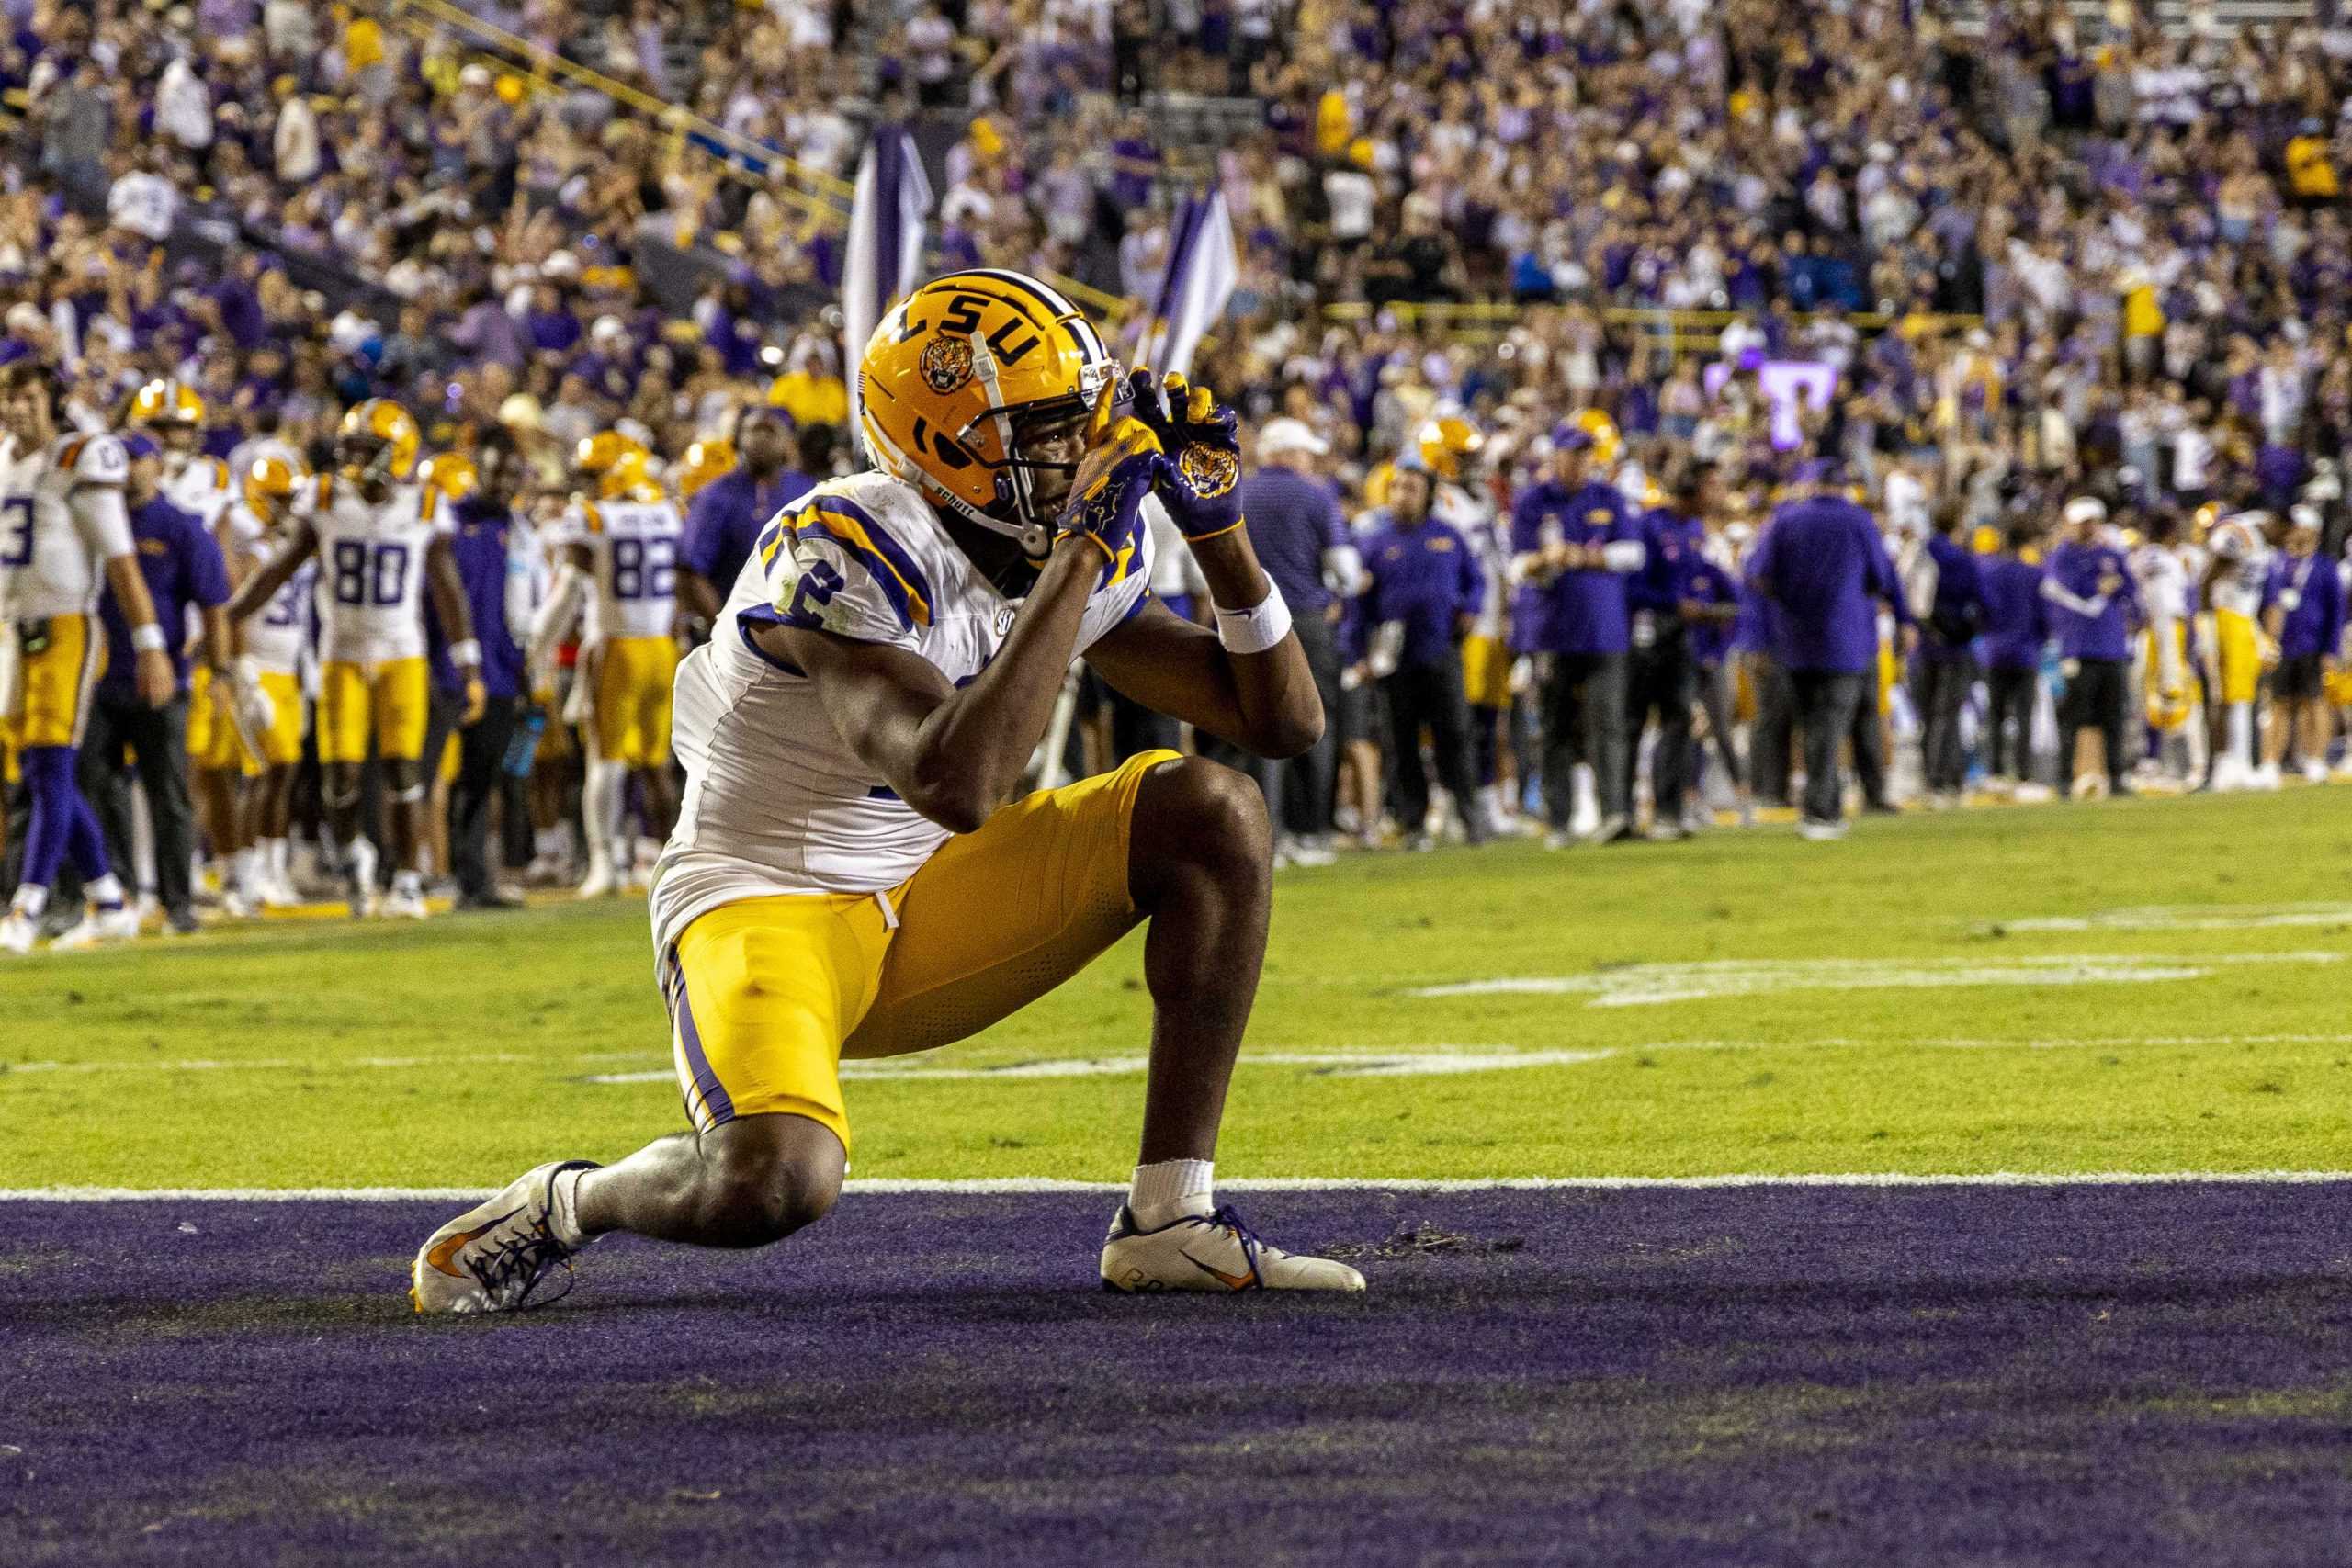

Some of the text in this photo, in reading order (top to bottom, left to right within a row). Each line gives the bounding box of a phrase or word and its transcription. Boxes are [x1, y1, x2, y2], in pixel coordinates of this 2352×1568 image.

[899, 294, 1041, 367] LSU
[335, 540, 407, 604] 80
[789, 559, 845, 629] 2
